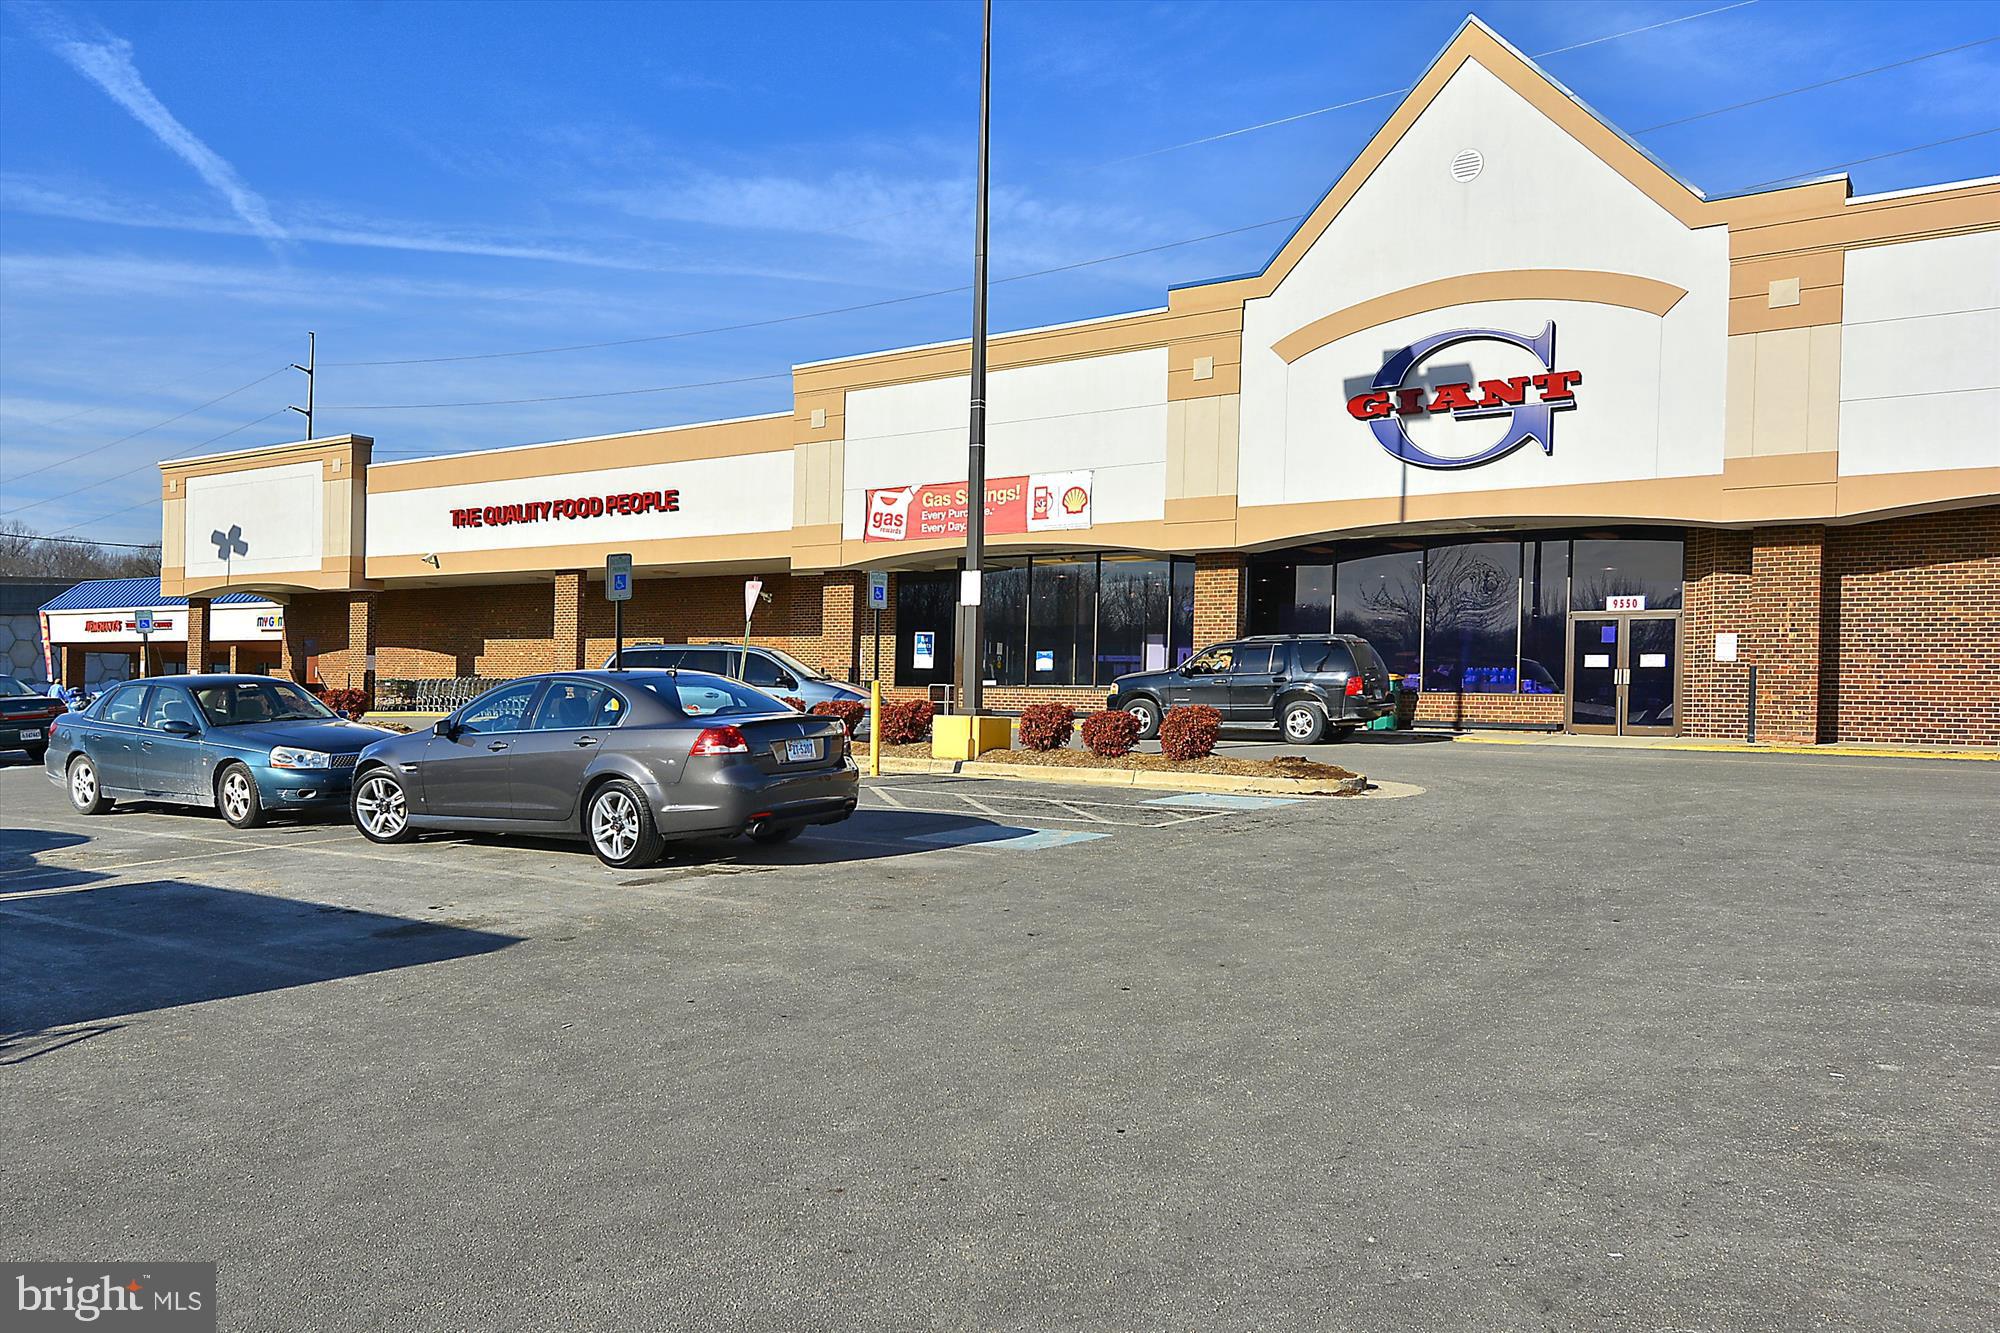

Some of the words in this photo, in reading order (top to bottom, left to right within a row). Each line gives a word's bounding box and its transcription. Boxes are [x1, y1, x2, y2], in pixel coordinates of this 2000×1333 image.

[1347, 370, 1582, 421] GIANT
[922, 491, 951, 508] Gas
[955, 484, 1021, 506] Sings!
[450, 508, 482, 529] THE
[483, 502, 551, 527] QUALITY
[552, 497, 603, 521] FOOD
[605, 489, 680, 517] PEOPLE
[921, 510, 946, 521] Every
[872, 511, 904, 529] gas
[880, 527, 902, 535] rewards
[921, 523, 946, 534] Every
[1613, 598, 1638, 609] 9550
